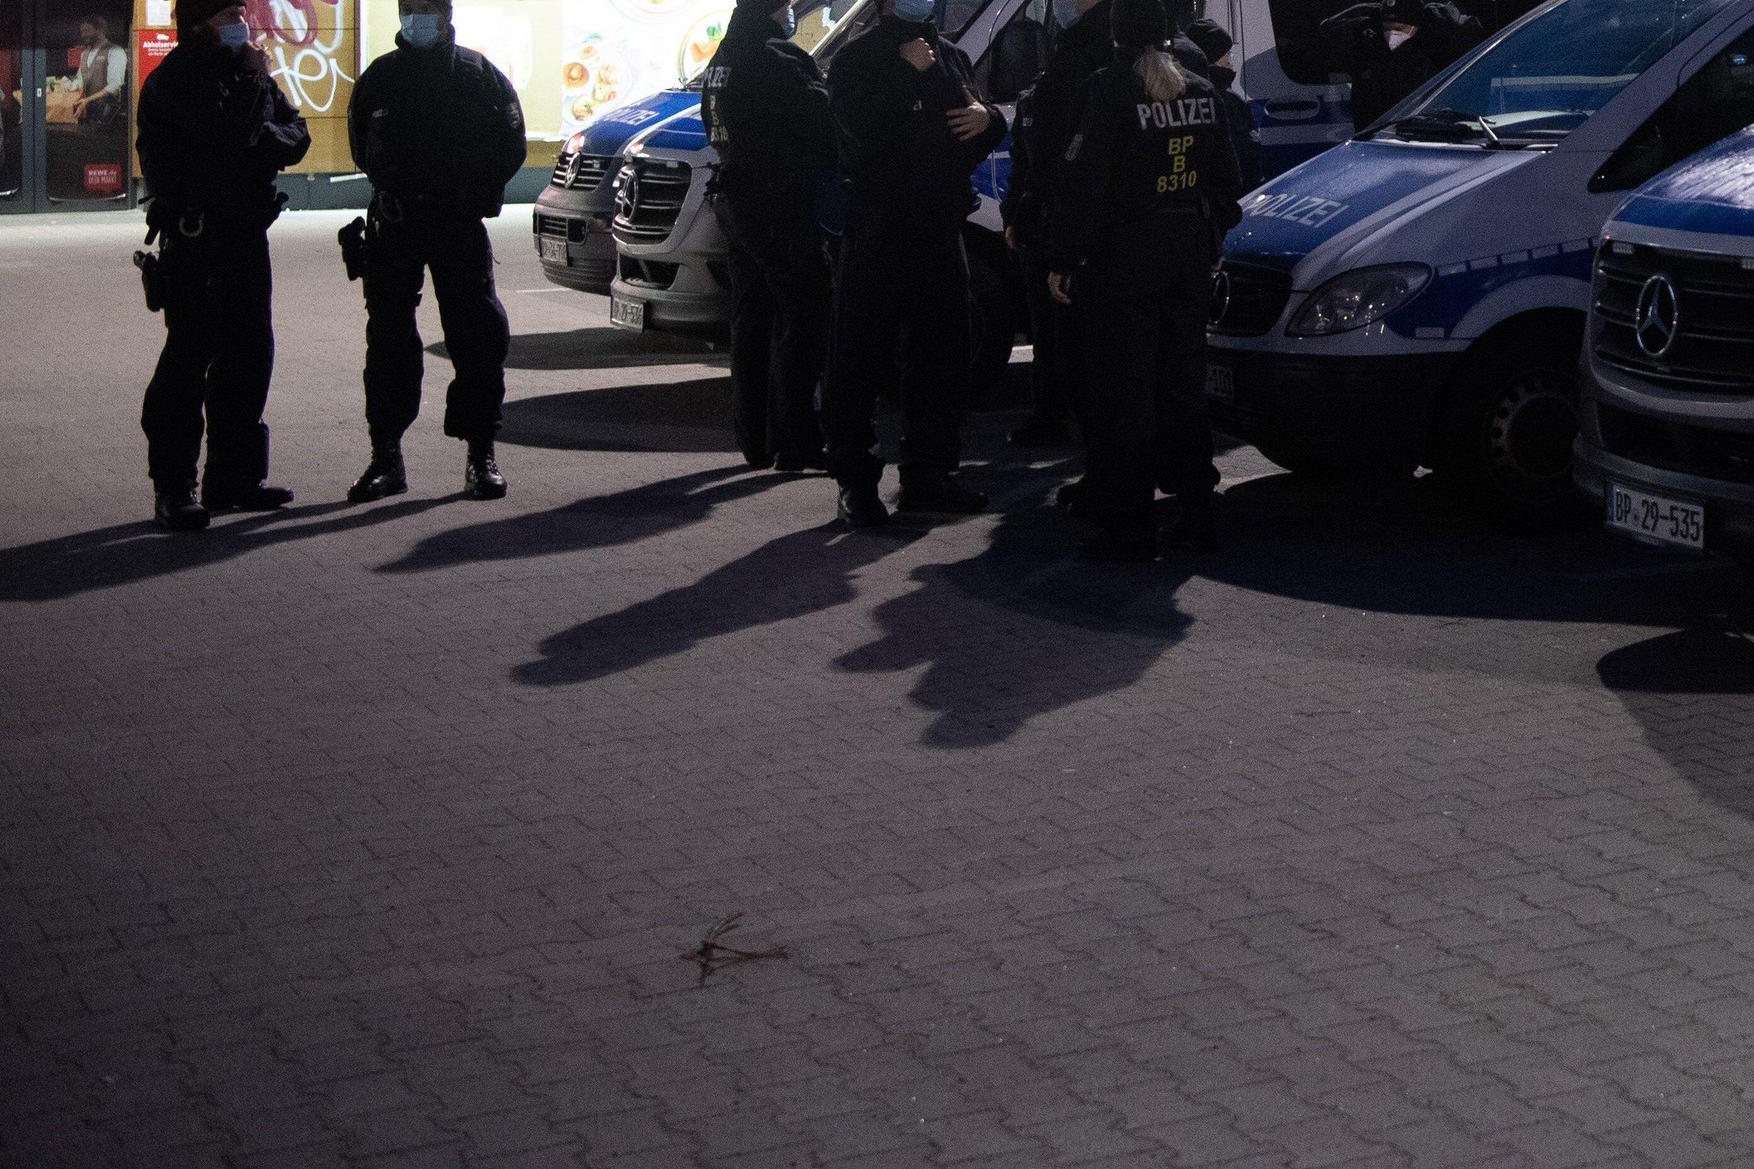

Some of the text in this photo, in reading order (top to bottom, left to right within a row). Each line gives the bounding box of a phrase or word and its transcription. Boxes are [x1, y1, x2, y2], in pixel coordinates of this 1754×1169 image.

[1136, 97, 1216, 131] POLIZEI
[1168, 135, 1195, 155] BP
[1172, 155, 1186, 173] B
[1156, 170, 1198, 193] 8310
[1615, 491, 1700, 542] BP 29-535
